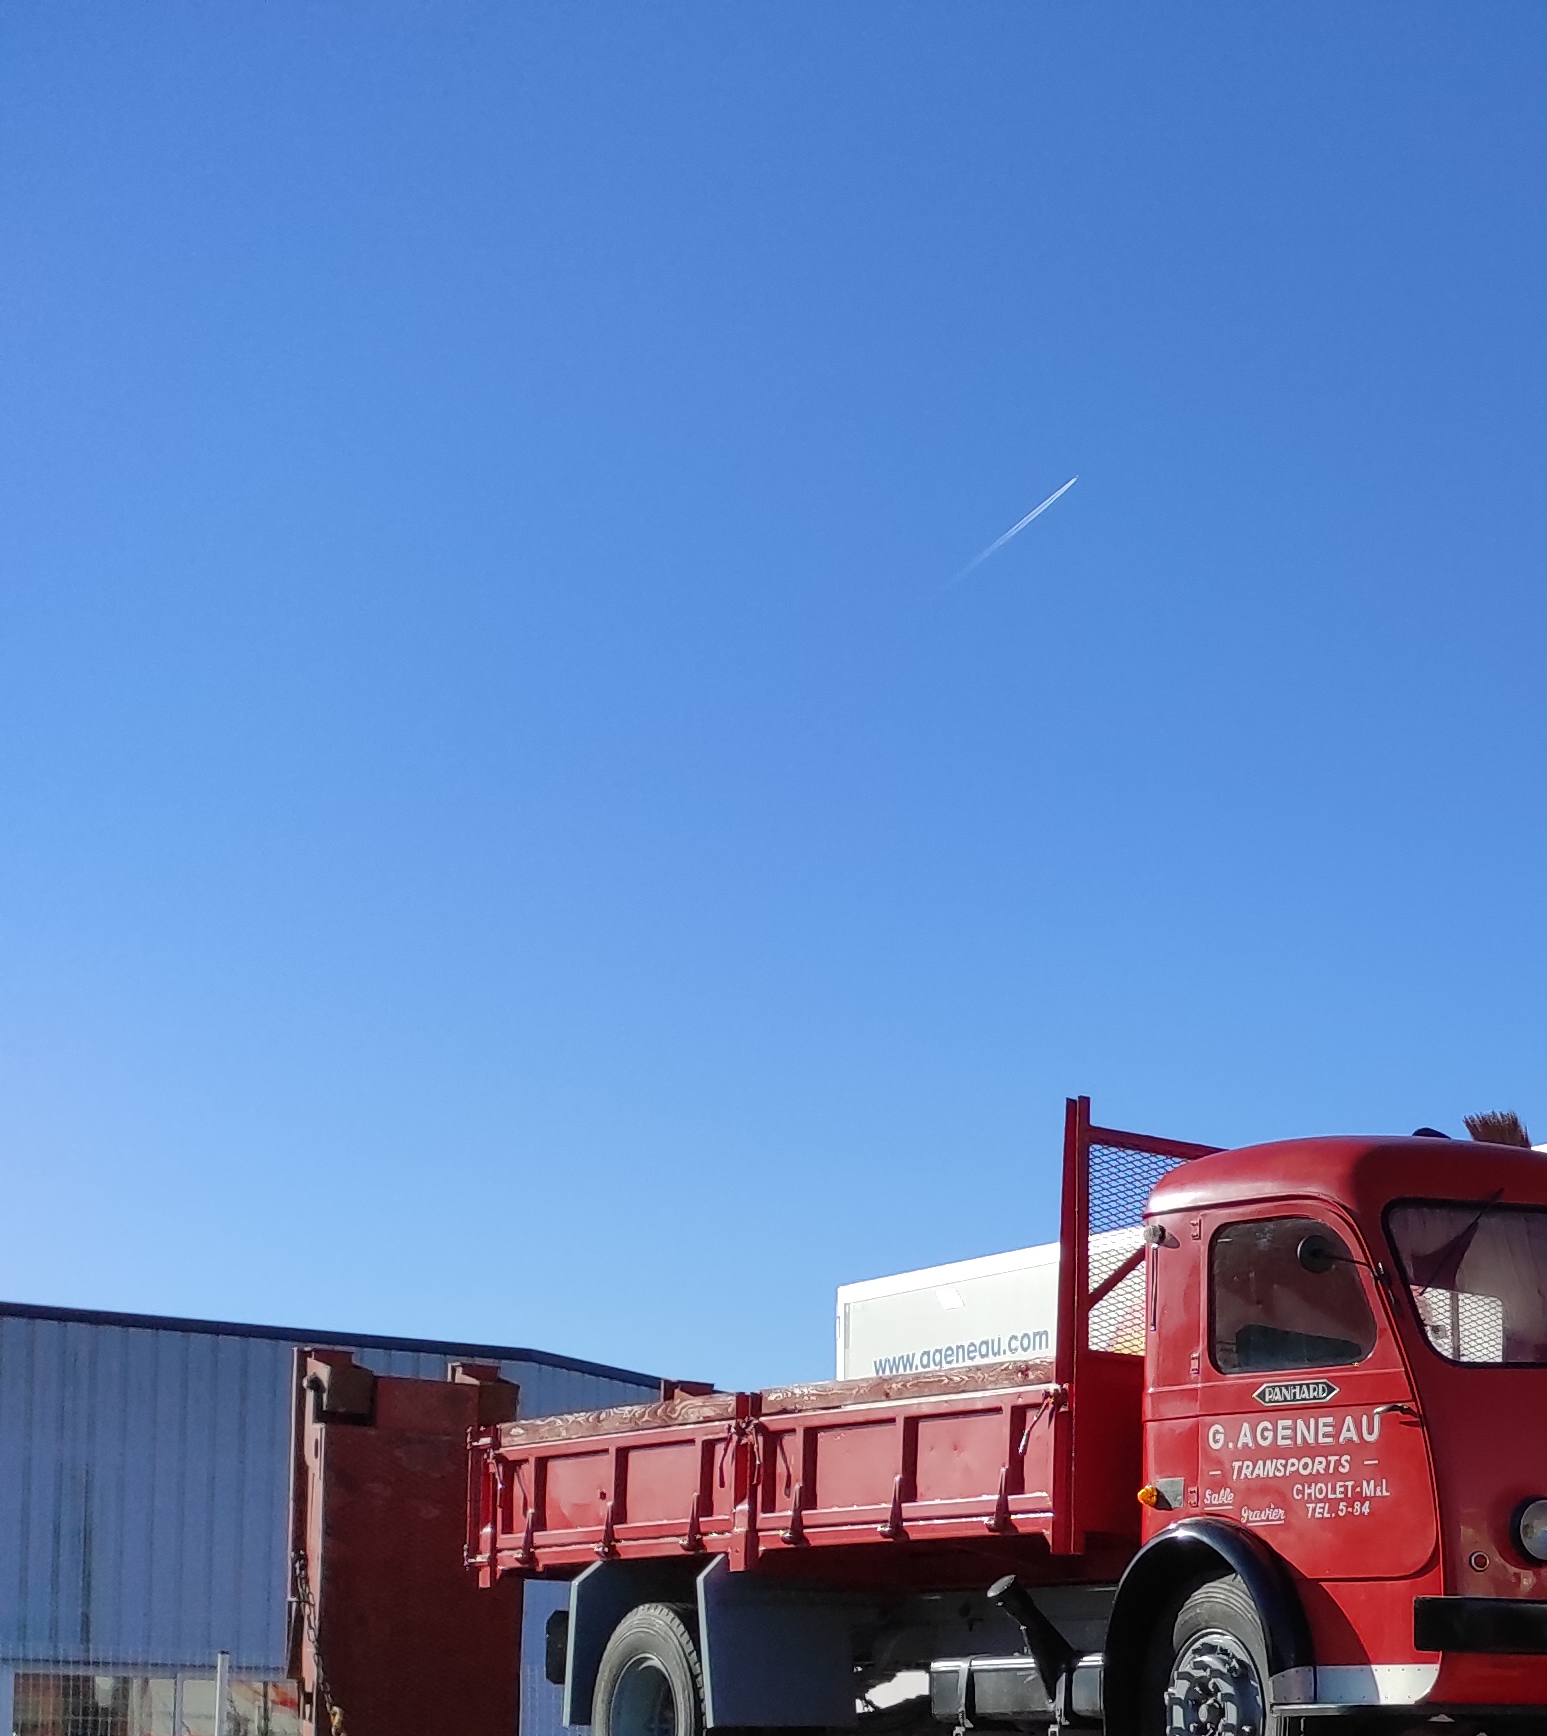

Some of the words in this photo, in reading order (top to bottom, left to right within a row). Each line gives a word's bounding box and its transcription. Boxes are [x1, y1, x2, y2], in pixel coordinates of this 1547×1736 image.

[873, 1329, 1050, 1376] www.ageneau.com
[1265, 1384, 1328, 1402] PANHARD
[1232, 1454, 1352, 1481] TRANSPORTS
[1203, 1487, 1235, 1504] Sable
